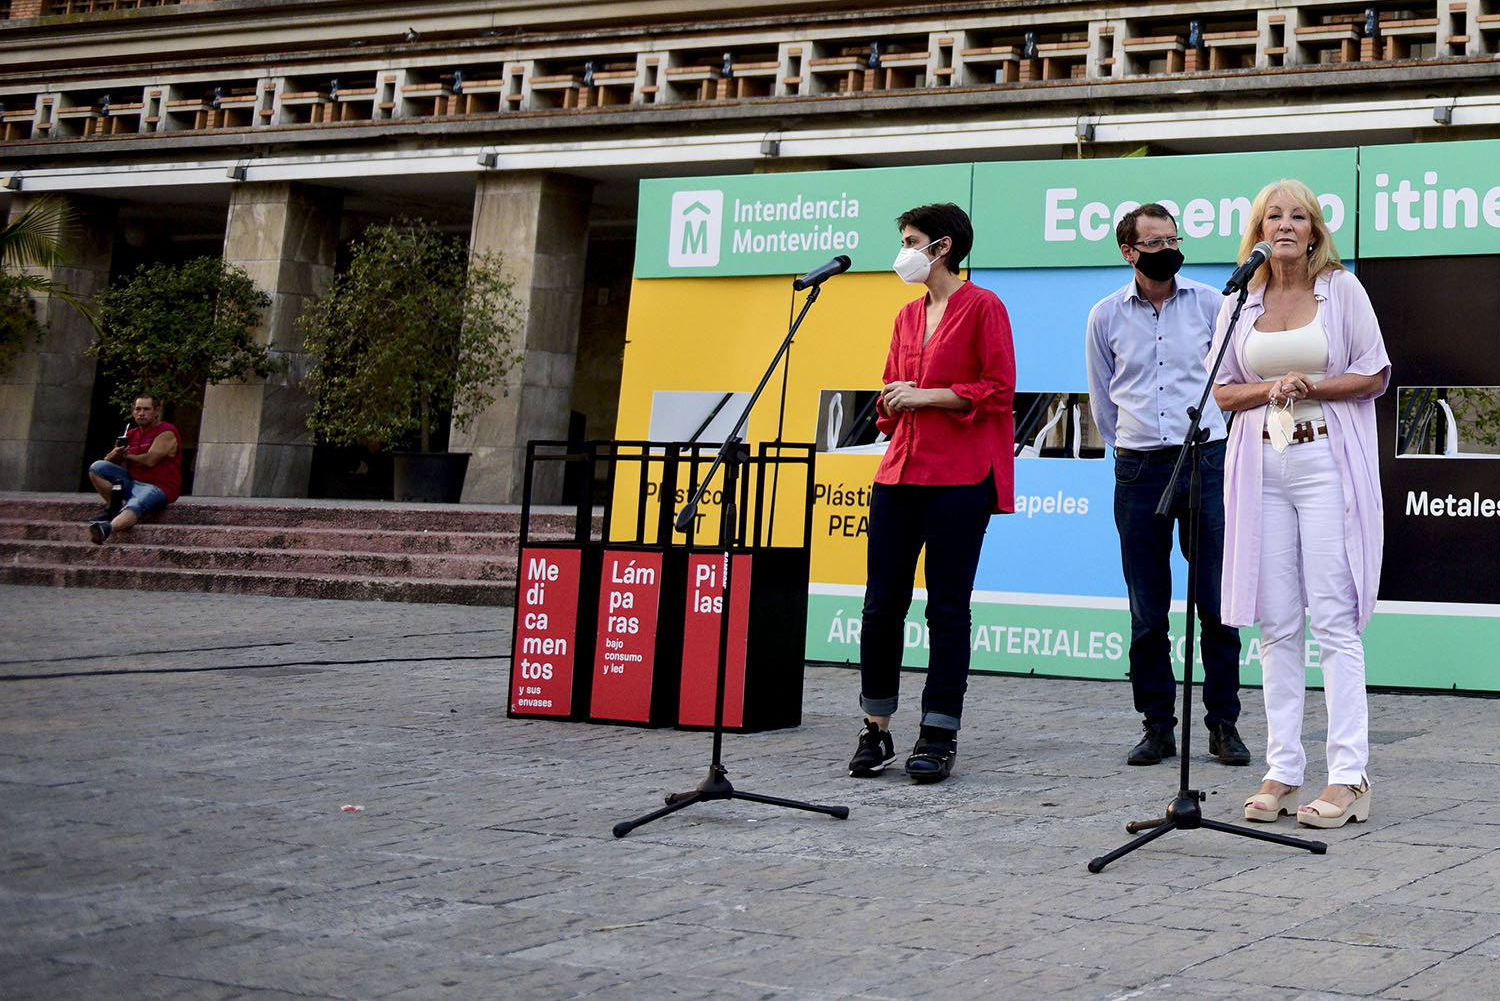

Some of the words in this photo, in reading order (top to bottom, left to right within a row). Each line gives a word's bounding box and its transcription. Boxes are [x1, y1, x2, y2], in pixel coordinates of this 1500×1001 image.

[734, 192, 860, 223] Intendencia
[732, 224, 860, 254] Montevideo
[1015, 490, 1089, 519] apeles
[527, 558, 559, 582] Me
[611, 559, 656, 585] Lám
[695, 563, 717, 589] Pi
[526, 582, 545, 606] di
[608, 590, 635, 614] pa
[693, 588, 723, 614] las
[524, 612, 549, 630] ca
[607, 615, 640, 635] ras
[522, 636, 567, 655] men
[605, 637, 624, 650] bajo
[973, 624, 1123, 661] ATERIALES
[520, 658, 554, 680] tos
[602, 664, 610, 675] y
[610, 662, 625, 674] led
[604, 652, 642, 662] consumo
[518, 686, 525, 696] y
[526, 686, 541, 695] sus
[518, 698, 552, 707] envases
